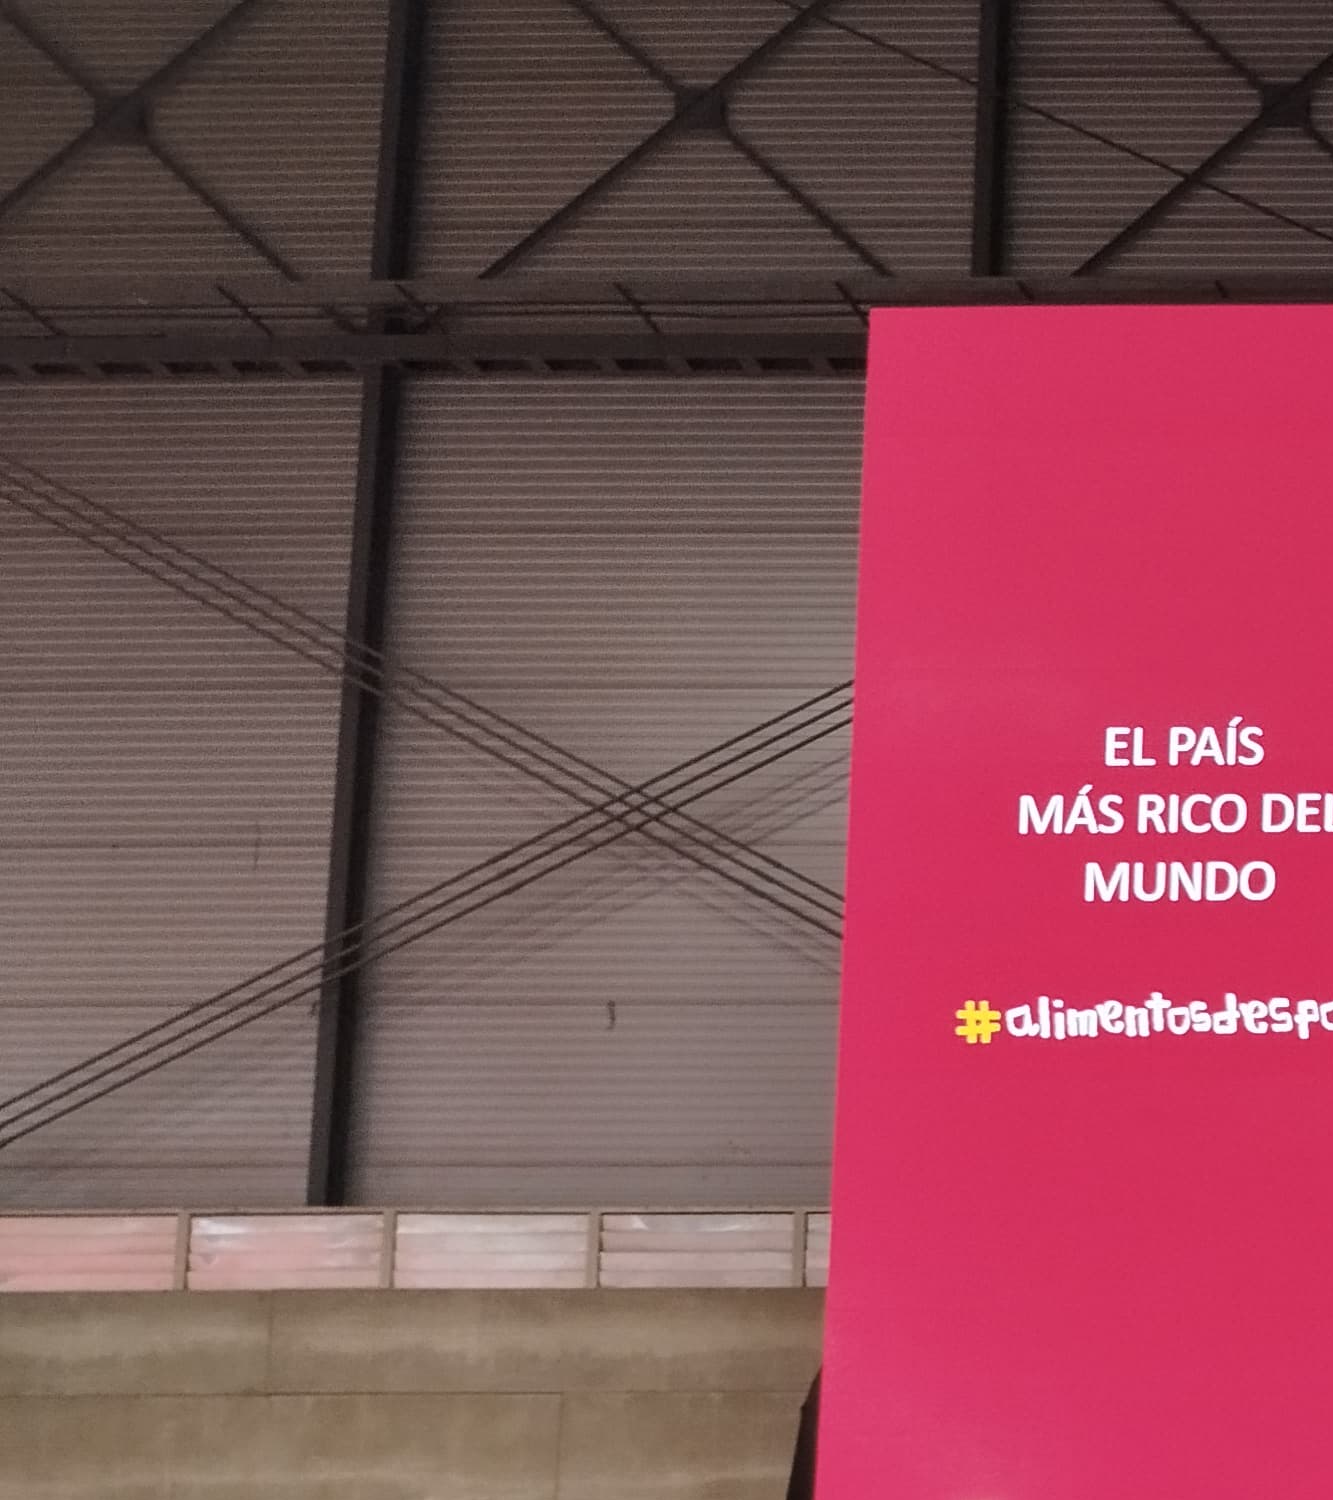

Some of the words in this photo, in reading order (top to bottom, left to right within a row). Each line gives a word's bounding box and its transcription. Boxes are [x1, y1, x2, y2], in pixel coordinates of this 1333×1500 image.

[1104, 726, 1157, 767] EL
[1168, 716, 1265, 767] PAÍS
[1018, 783, 1125, 835] MÁS
[1137, 793, 1248, 834] RICO
[1084, 860, 1276, 902] MUNDO
